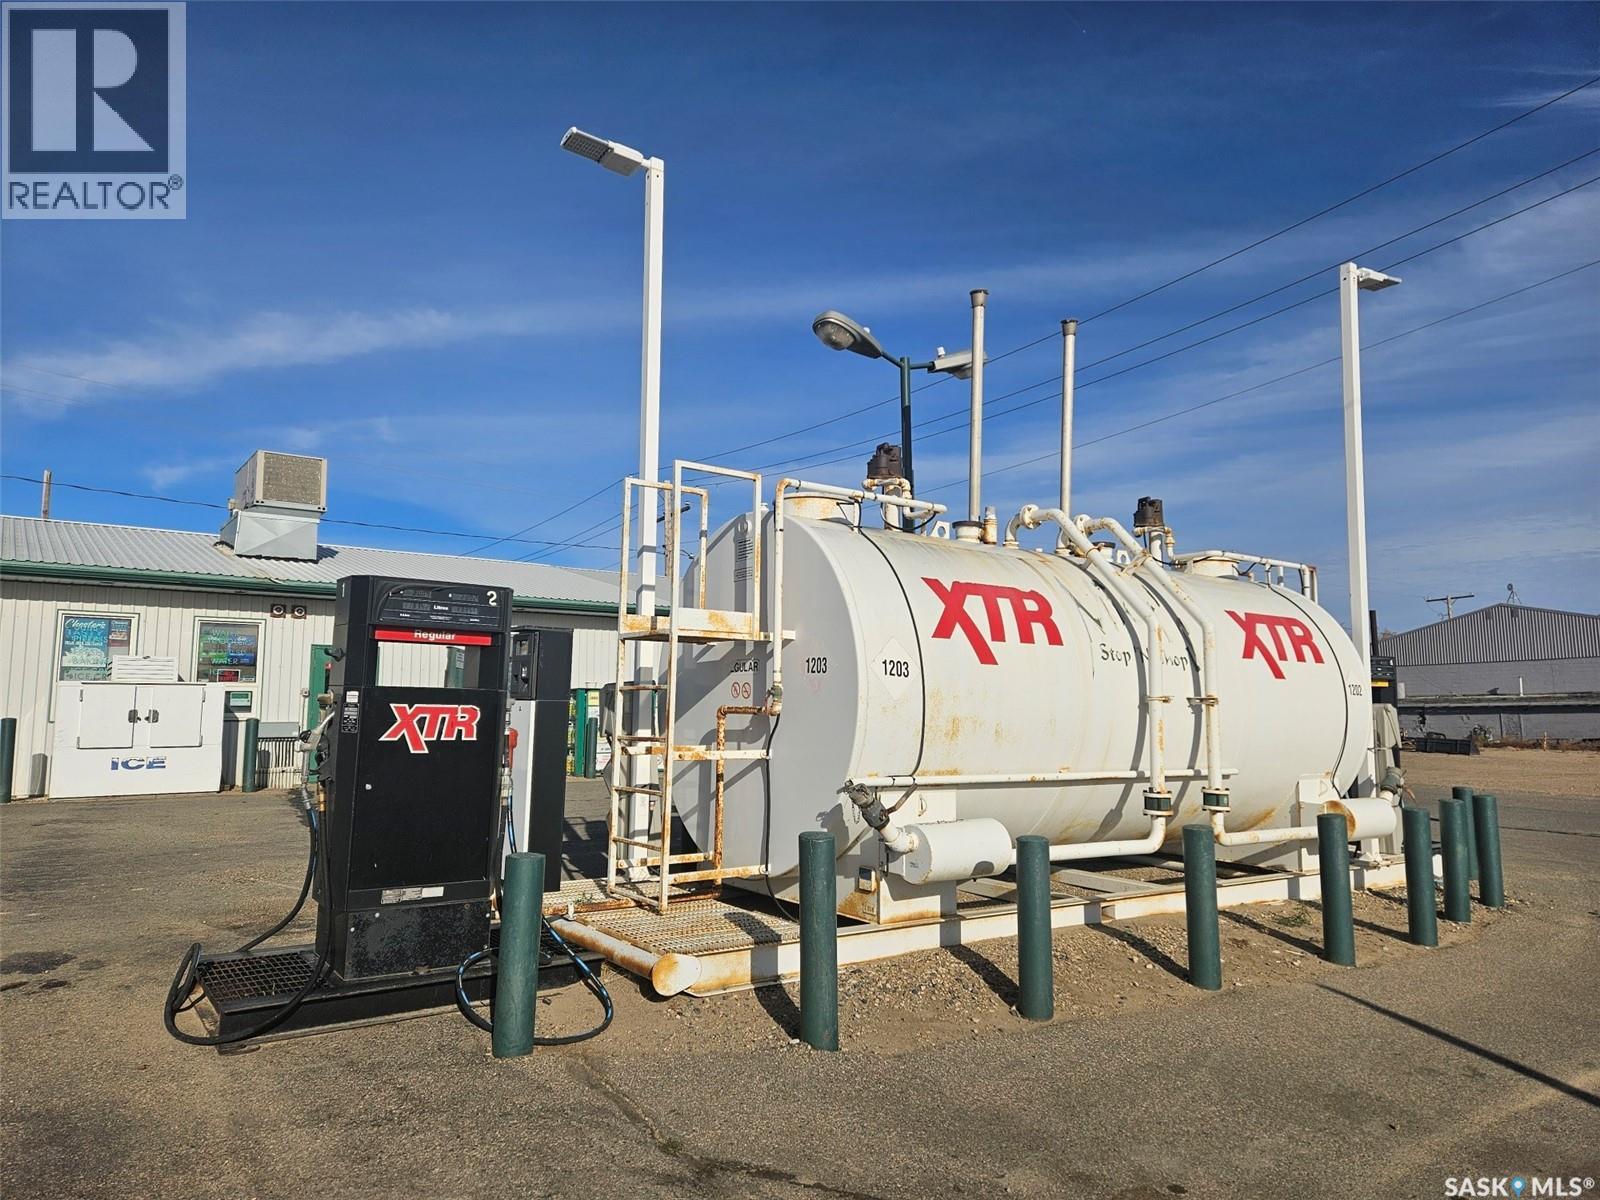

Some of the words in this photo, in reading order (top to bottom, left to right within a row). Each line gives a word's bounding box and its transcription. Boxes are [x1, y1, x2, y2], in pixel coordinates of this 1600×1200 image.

[486, 591, 497, 606] 2
[921, 577, 1064, 666] XTR
[414, 629, 456, 641] Regular
[1224, 610, 1325, 680] XTR
[805, 657, 828, 674] 1203
[1100, 643, 1131, 667] Stop
[1161, 654, 1188, 671] hop
[882, 659, 910, 678] 1203
[378, 704, 480, 754] XTR
[110, 756, 167, 770] ICE
